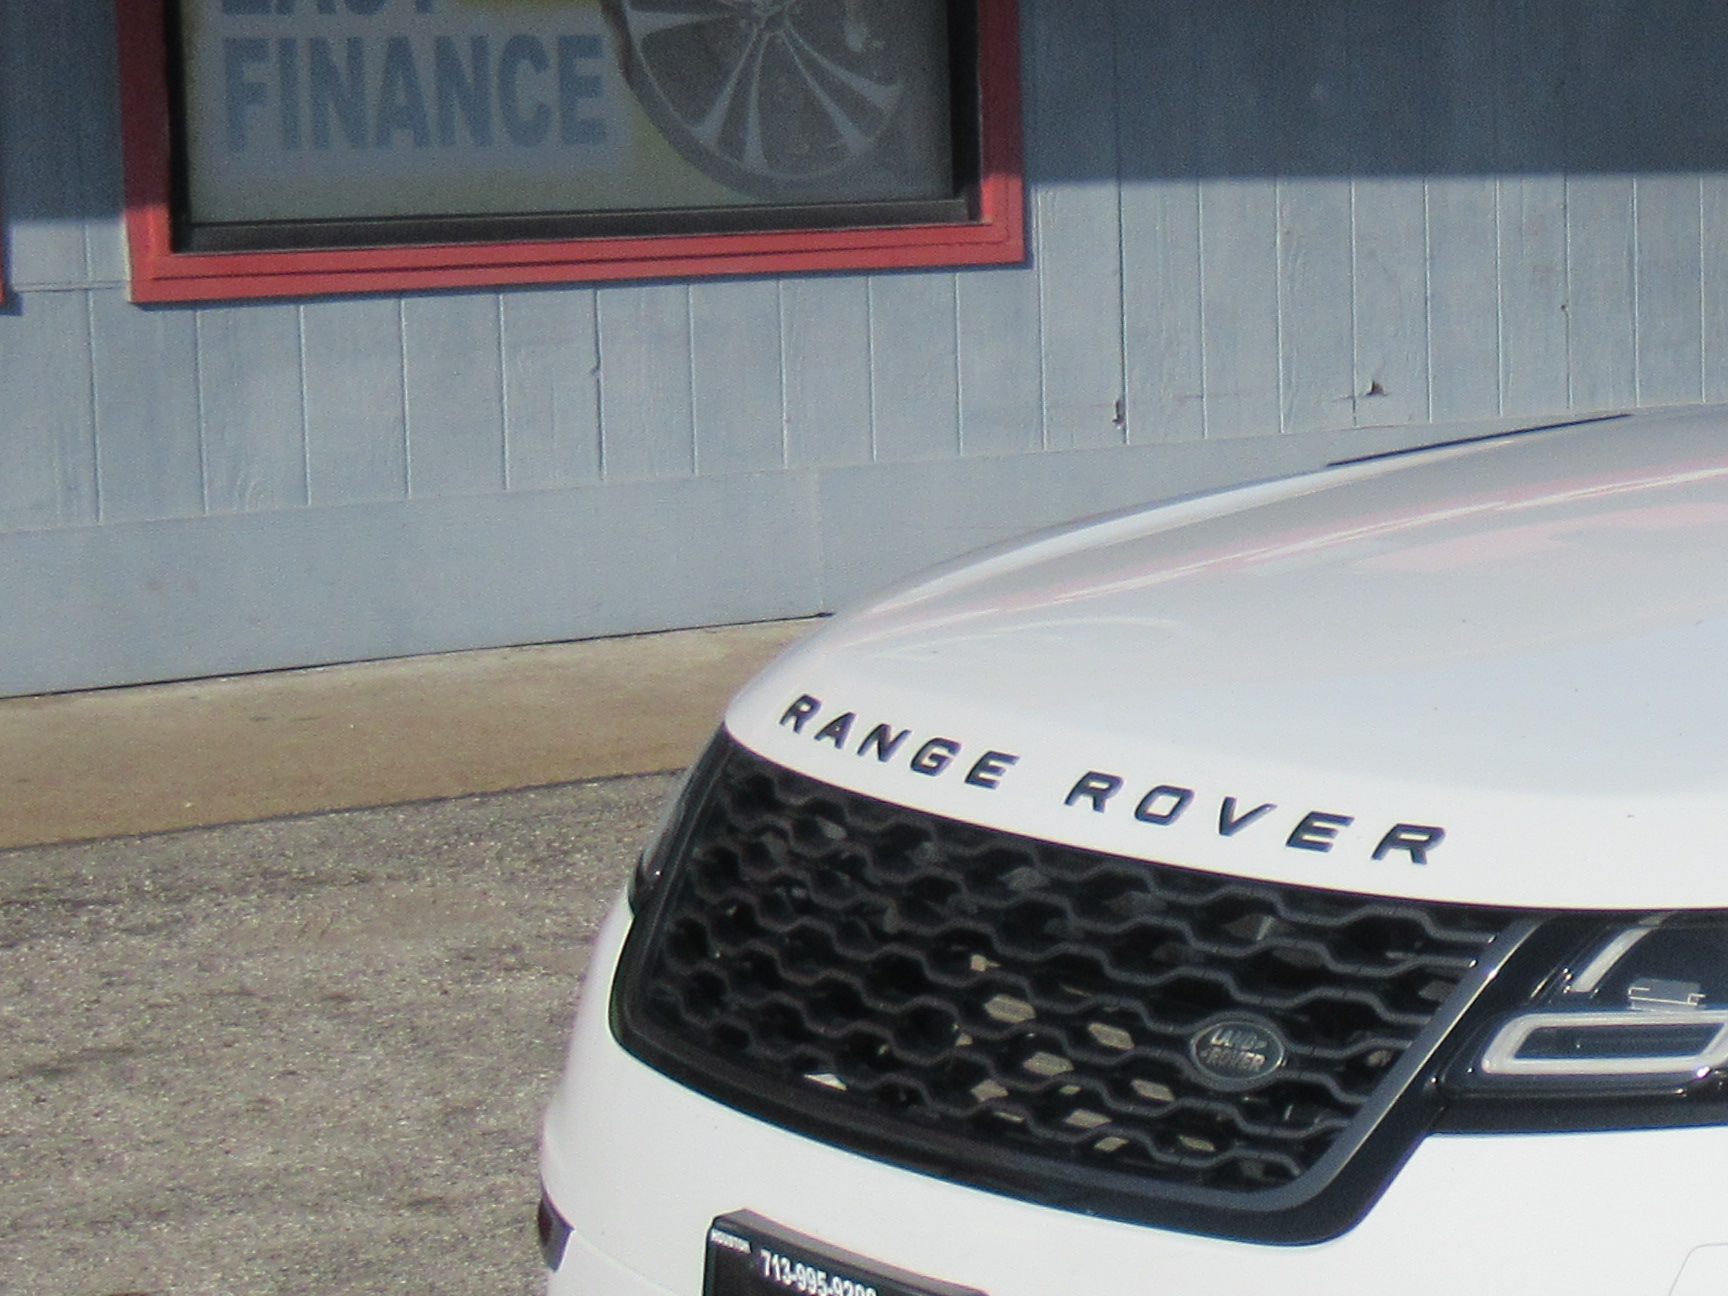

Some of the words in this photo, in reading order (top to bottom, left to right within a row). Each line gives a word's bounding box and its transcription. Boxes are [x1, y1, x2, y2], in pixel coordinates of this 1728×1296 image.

[221, 33, 608, 152] FINANCE
[779, 692, 1020, 790] RANGE
[1063, 771, 1446, 866] ROVER
